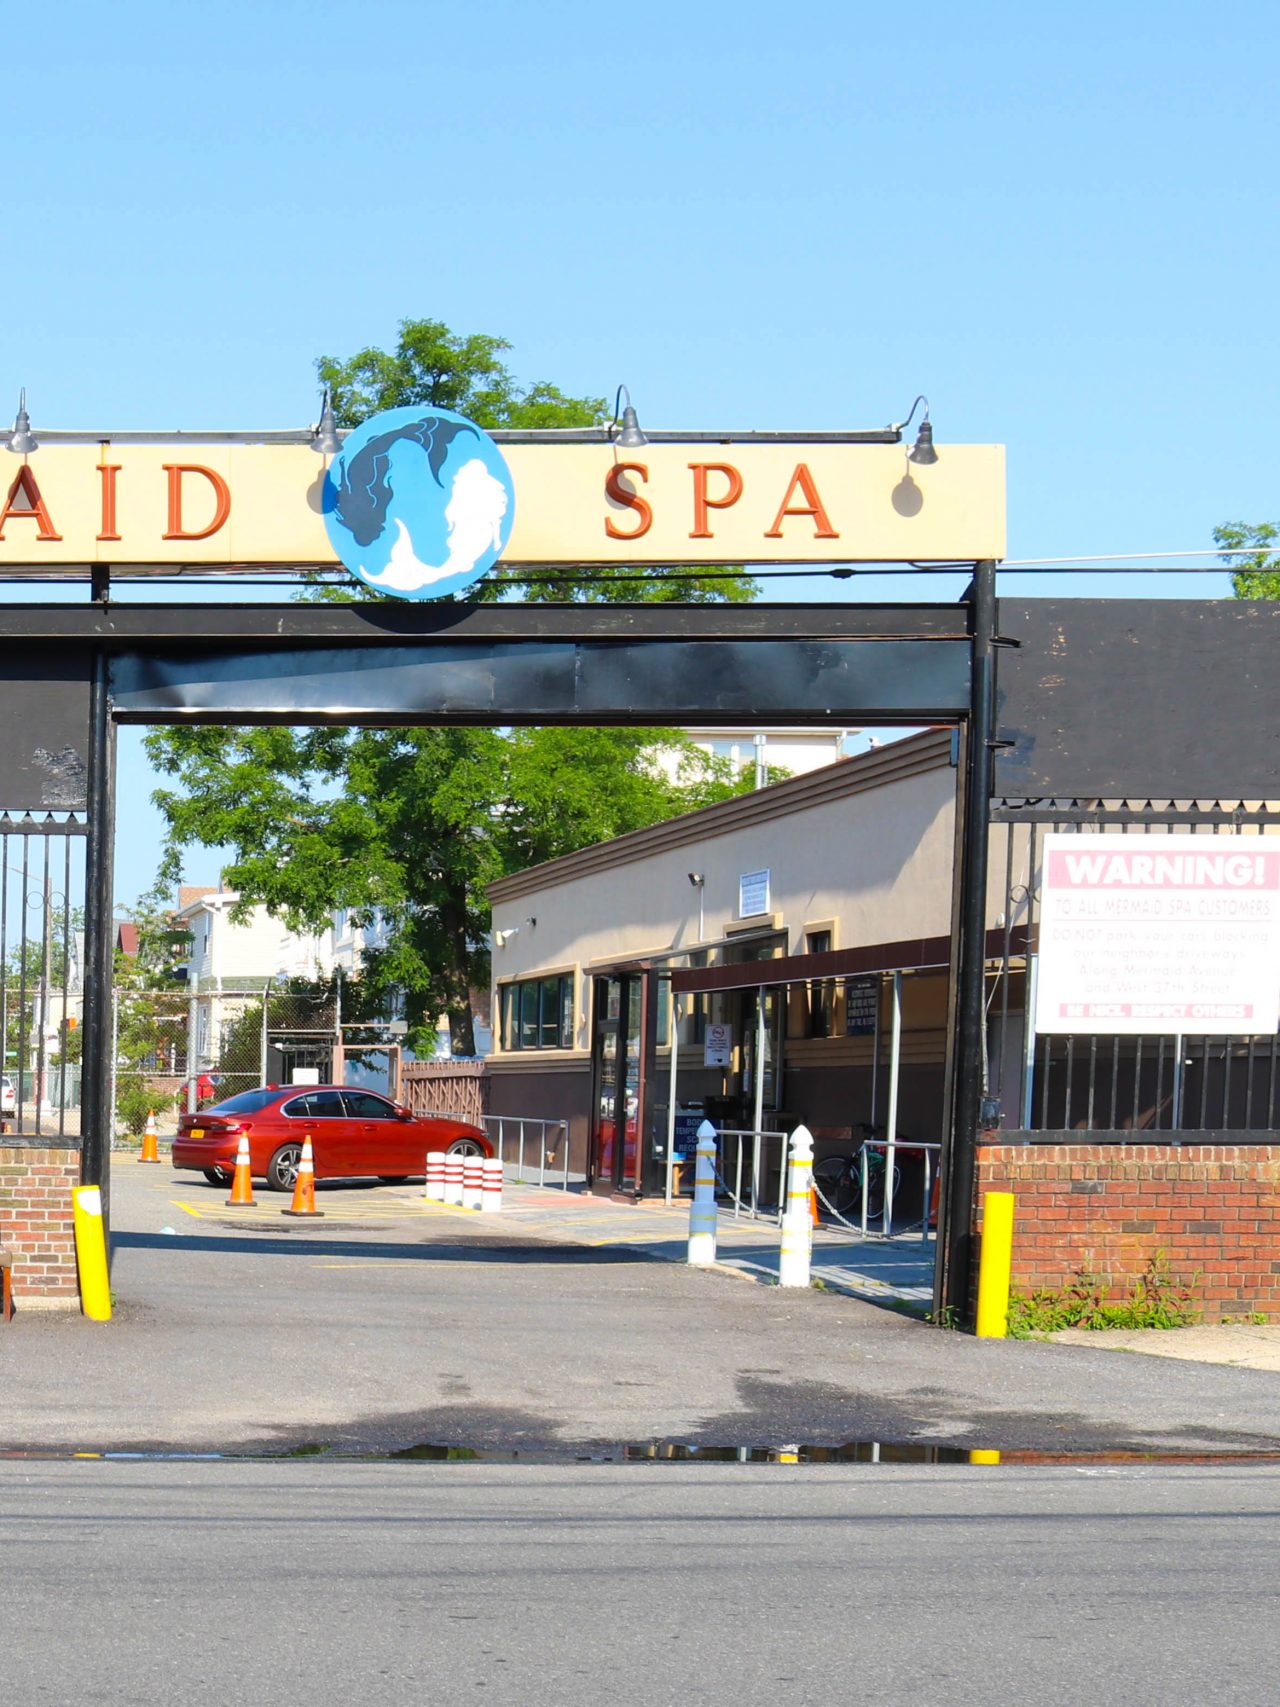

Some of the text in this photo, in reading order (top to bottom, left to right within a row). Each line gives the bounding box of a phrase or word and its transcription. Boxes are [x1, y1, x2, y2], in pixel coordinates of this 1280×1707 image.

[603, 461, 840, 541] SPA
[1064, 854, 1266, 886] WARNING!
[1055, 898, 1271, 917] TO ALL MERMAID SPA CUSTOMERS
[1051, 928, 1071, 942] DO
[1075, 928, 1102, 942] NOT
[1106, 928, 1137, 945] park
[1191, 1004, 1245, 1017] OTHERS
